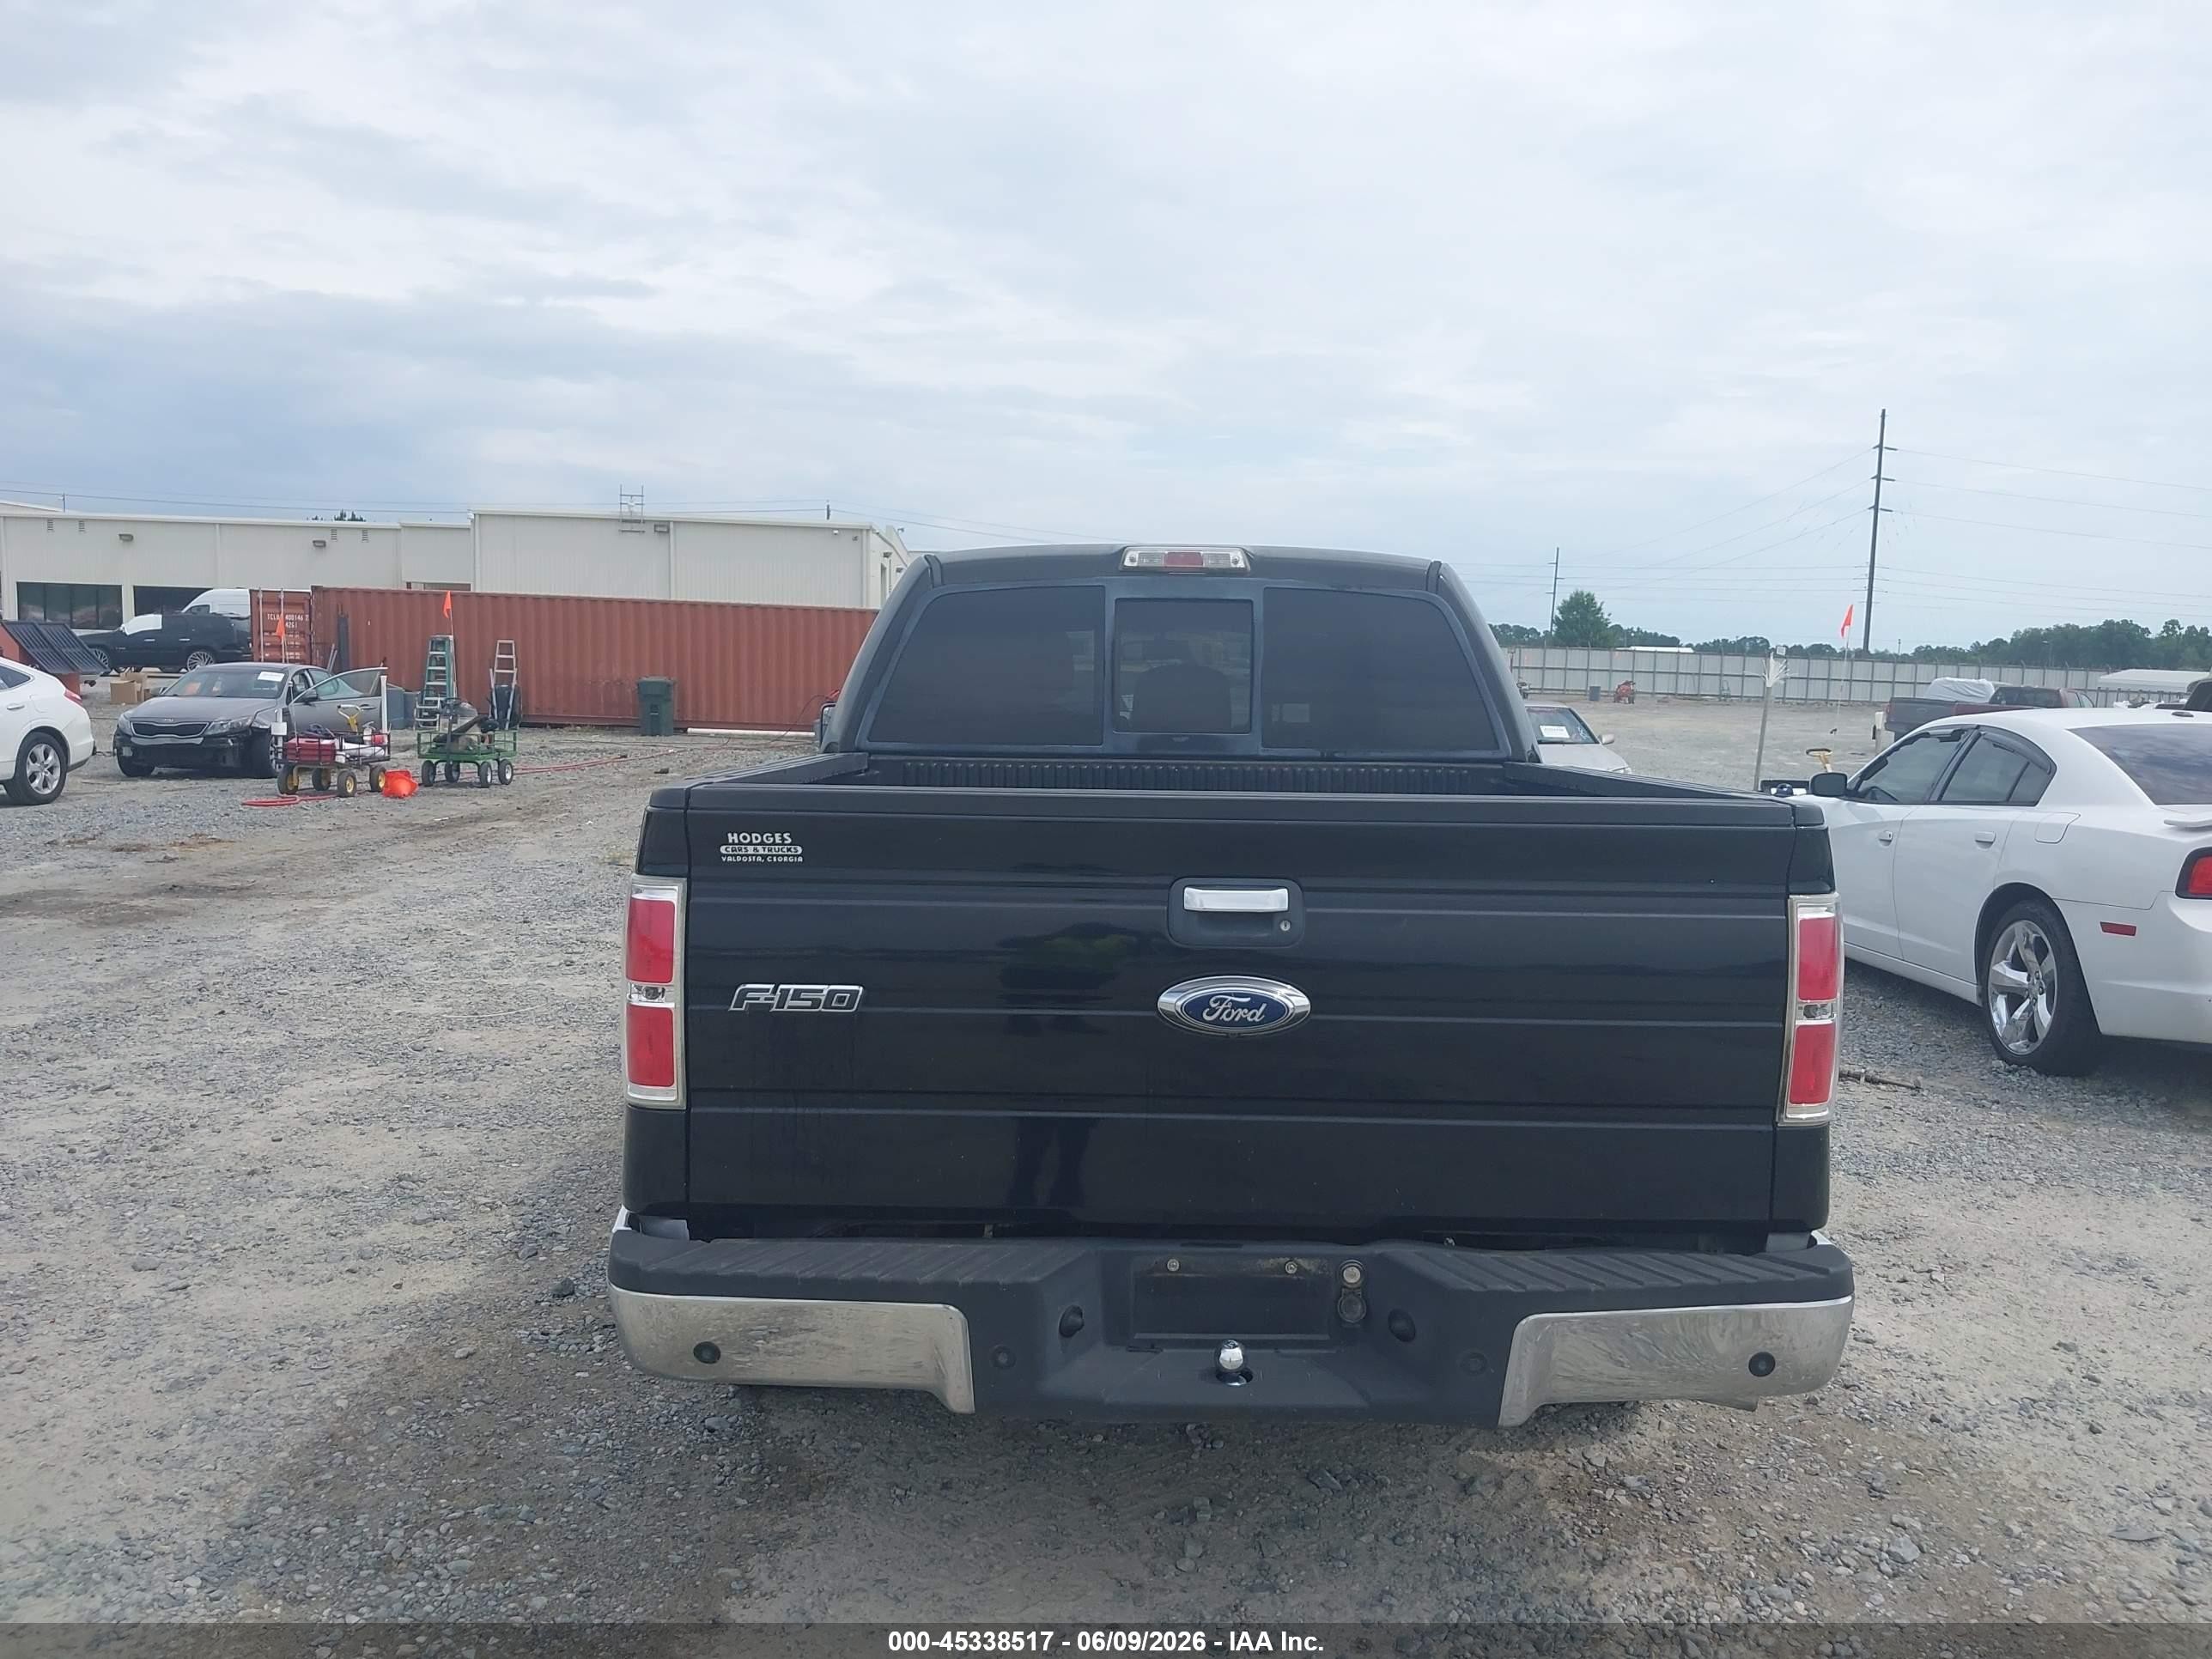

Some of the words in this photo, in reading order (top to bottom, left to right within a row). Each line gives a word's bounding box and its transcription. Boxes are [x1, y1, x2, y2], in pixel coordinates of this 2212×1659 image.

[727, 832, 792, 843] HODGES
[728, 983, 863, 1012] F-150
[1202, 994, 1267, 1022] Ford
